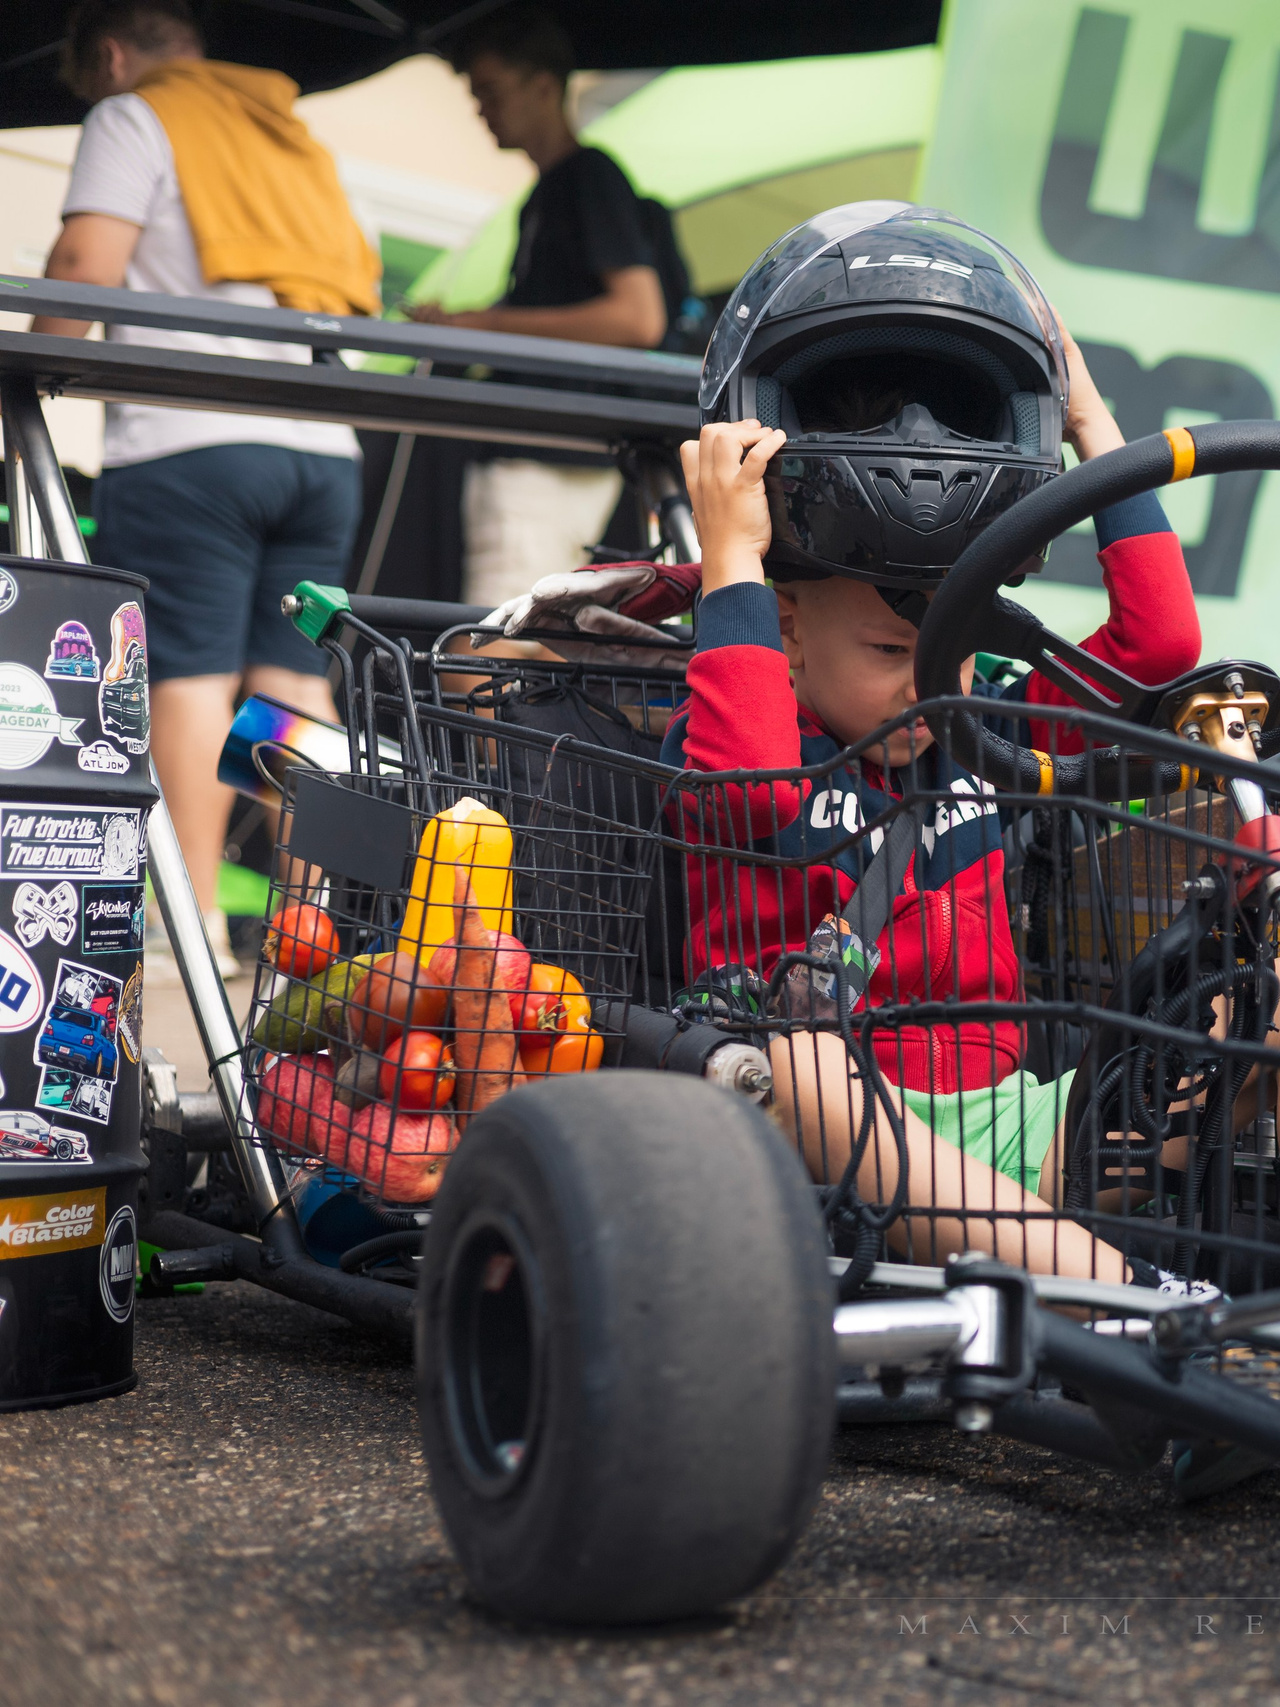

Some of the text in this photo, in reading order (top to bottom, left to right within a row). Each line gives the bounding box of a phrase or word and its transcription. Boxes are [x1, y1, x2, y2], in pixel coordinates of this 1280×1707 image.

[848, 254, 974, 280] LS2
[83, 759, 124, 770] ATL JDM
[2, 814, 37, 838] Full
[7, 843, 103, 867] True burnout
[46, 1204, 96, 1223] Color
[12, 1222, 93, 1246] Blaster
